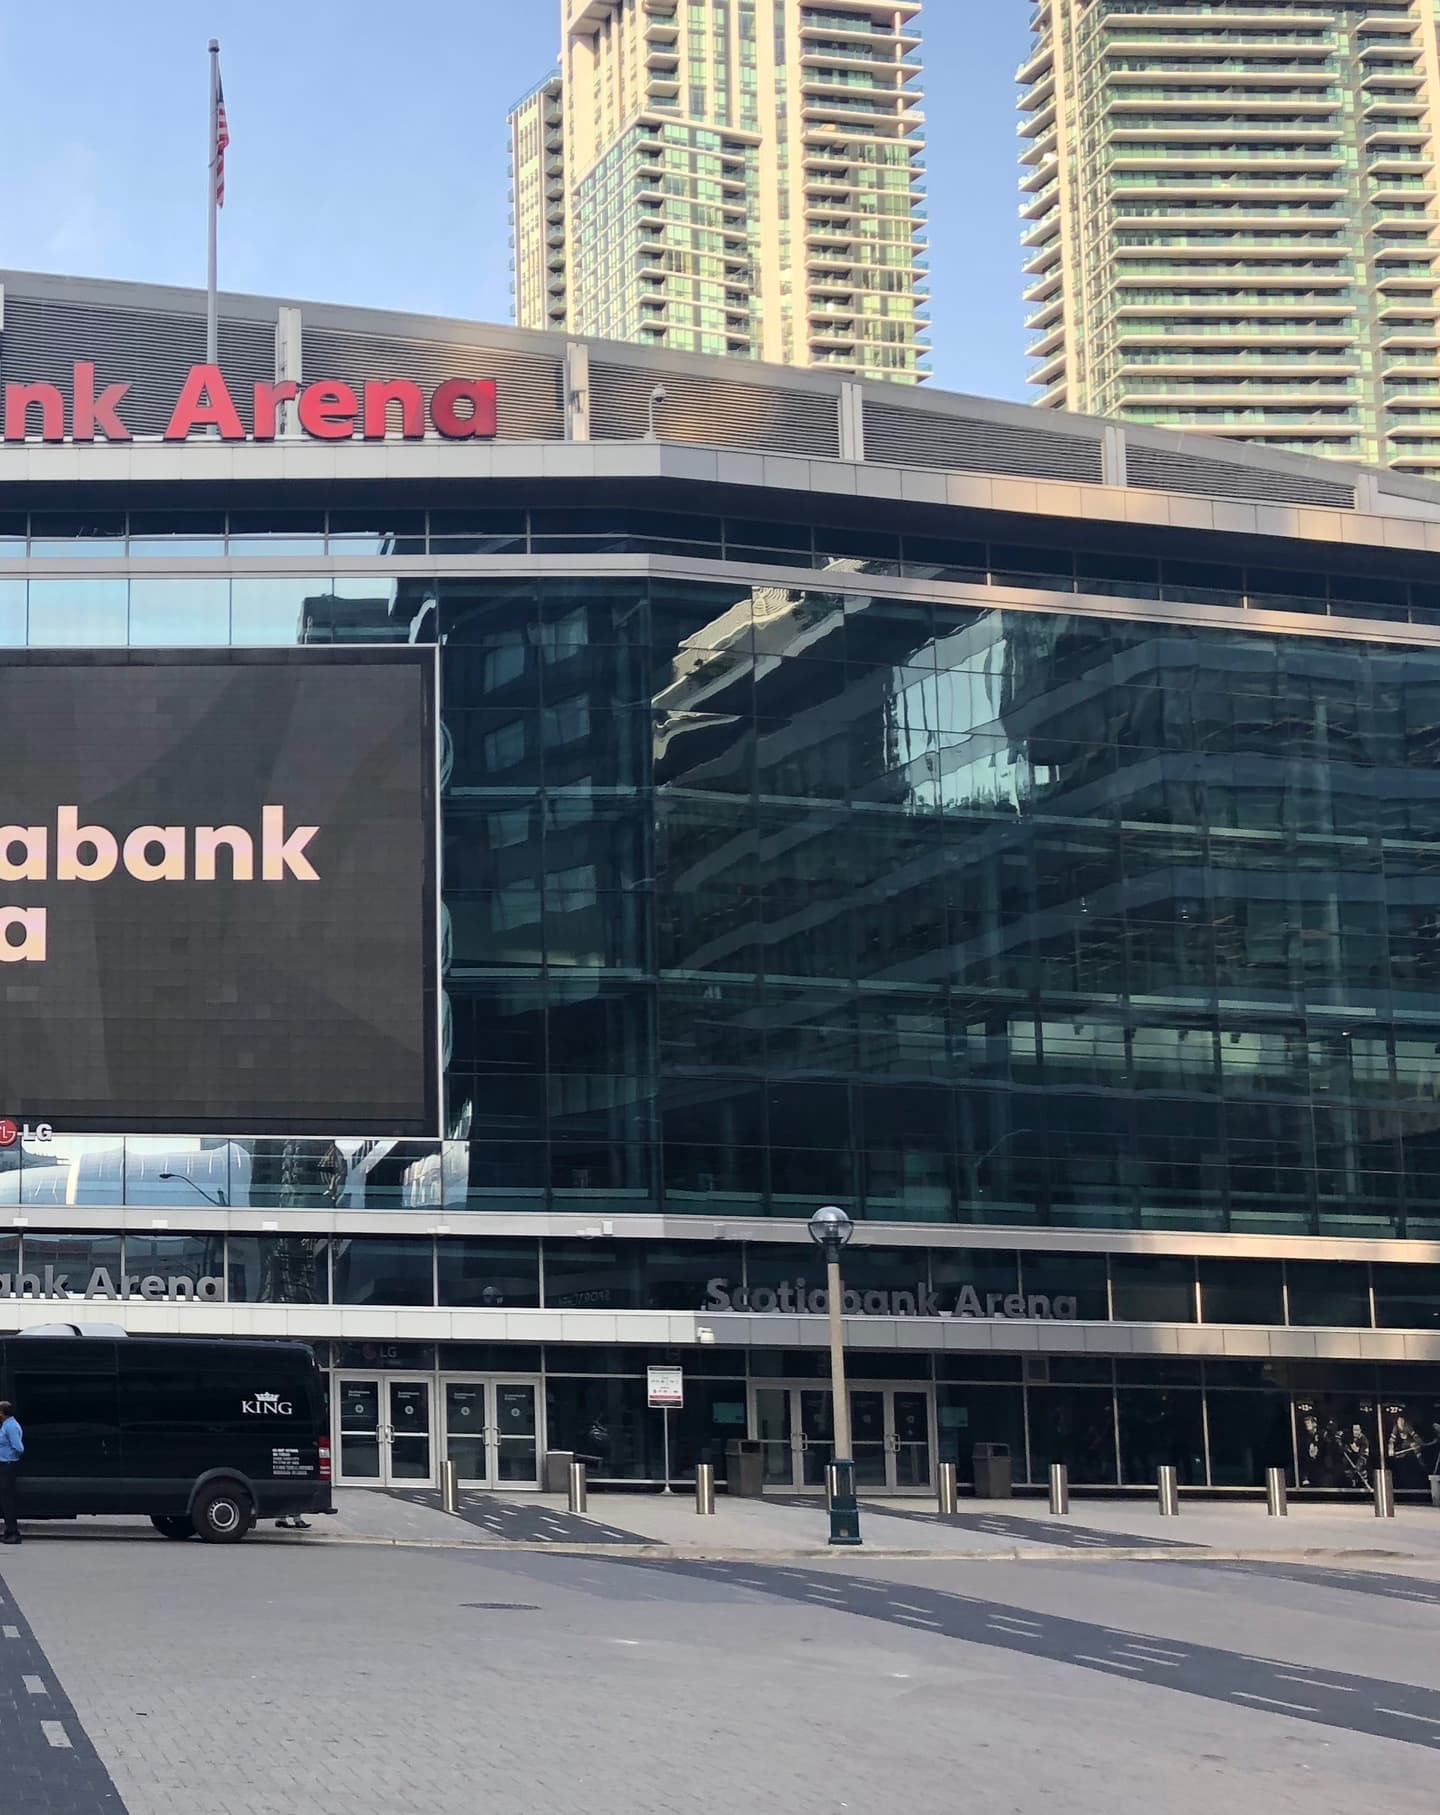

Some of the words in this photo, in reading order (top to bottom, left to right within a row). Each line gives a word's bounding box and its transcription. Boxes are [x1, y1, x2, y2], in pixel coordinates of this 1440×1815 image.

[163, 363, 498, 440] Arena
[22, 1122, 53, 1141] LG
[84, 1266, 226, 1301] Arena
[705, 1276, 941, 1317] Scotiabank
[951, 1284, 1077, 1320] Arena
[379, 1346, 398, 1358] LG
[241, 1400, 293, 1415] KING
